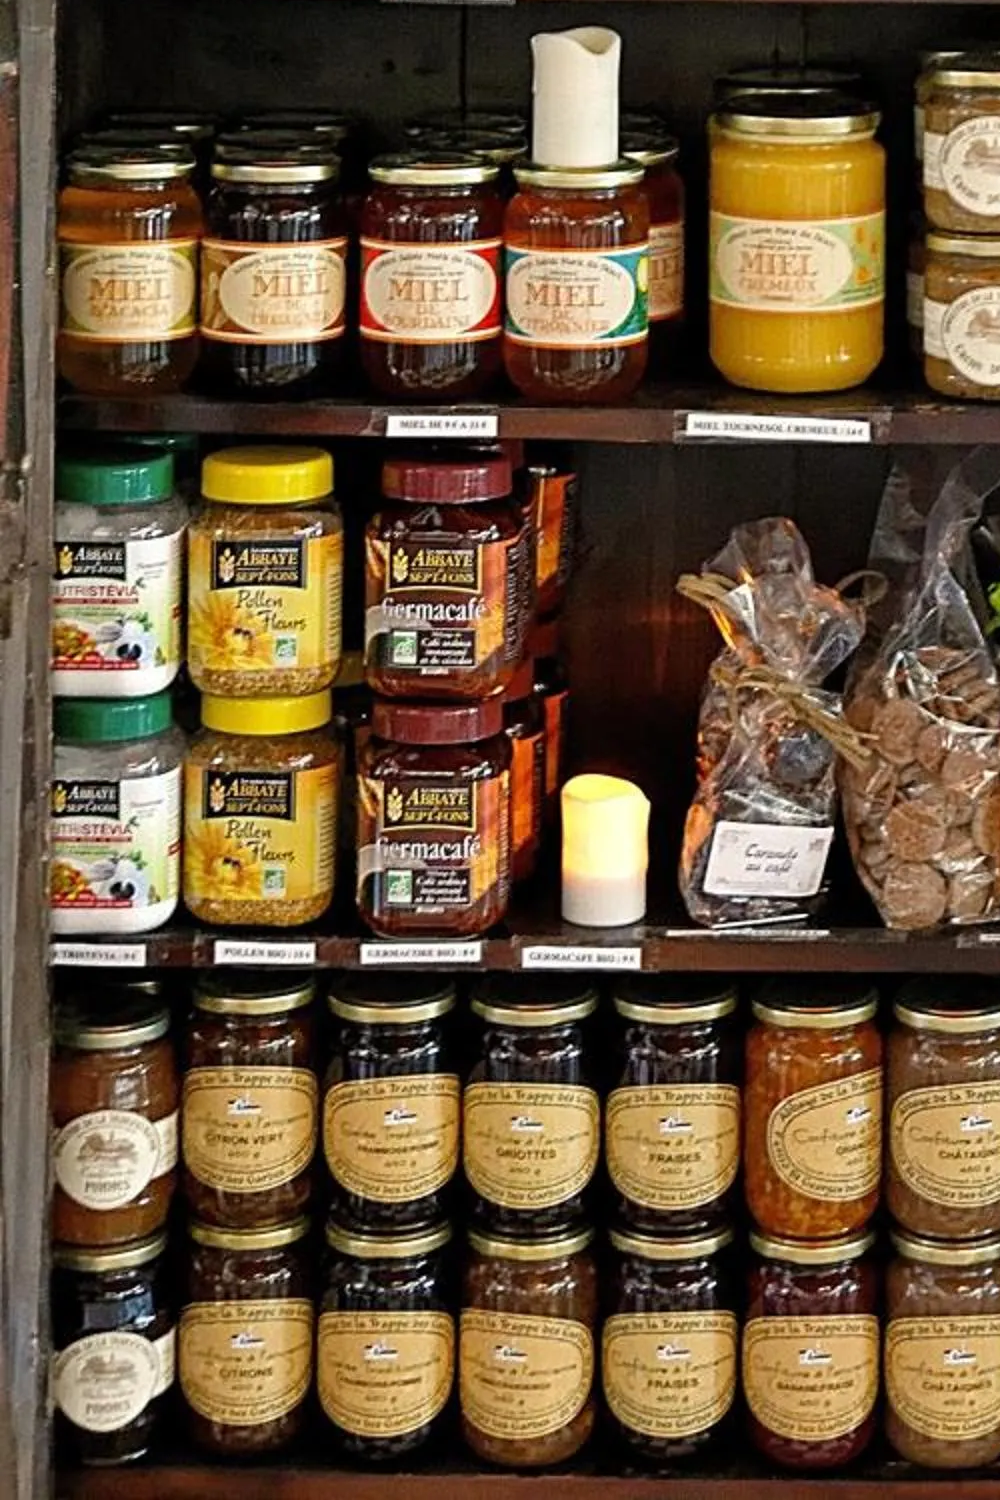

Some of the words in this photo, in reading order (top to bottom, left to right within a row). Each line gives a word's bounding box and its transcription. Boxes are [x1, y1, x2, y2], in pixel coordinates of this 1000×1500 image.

[738, 251, 818, 276] MIEL
[89, 278, 170, 301] MIEL
[252, 274, 331, 297] MIEL
[388, 278, 469, 302] MIEL
[524, 283, 605, 307] MIEL
[399, 419, 426, 429] MIEL
[693, 421, 719, 431] MIEL
[75, 545, 123, 562] ABBAYE
[235, 549, 298, 566] ABBAYE
[411, 550, 474, 568] ABBAYE
[235, 589, 284, 609] Pollen
[381, 597, 486, 621] Germacafé
[257, 609, 308, 632] Fleurs
[226, 781, 288, 798] ABBAYE
[406, 788, 469, 805] ABBAYE
[224, 819, 273, 839] Pollen
[246, 841, 296, 863] Fleurs
[376, 834, 481, 860] Germacafé
[204, 1131, 250, 1145] CITRON
[253, 1131, 285, 1145] VERT
[495, 1147, 557, 1160] GRIOTTES
[649, 1152, 701, 1163] FRAISES
[218, 1366, 273, 1378] CITRONS
[646, 1377, 699, 1388] FRAISES
